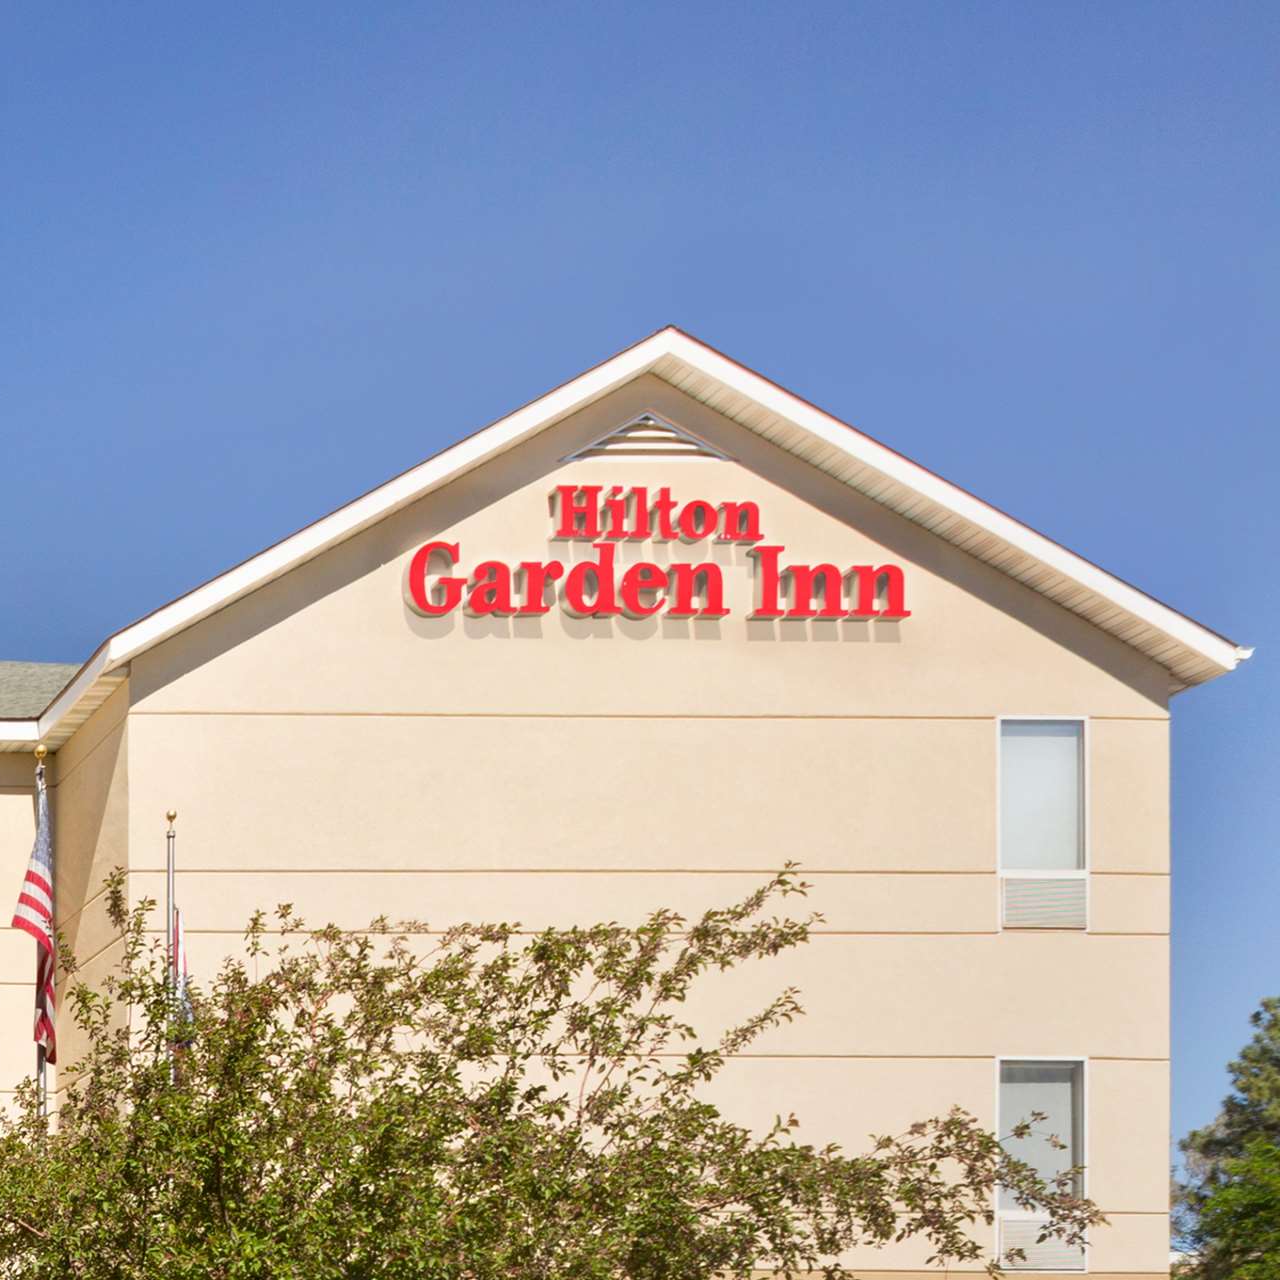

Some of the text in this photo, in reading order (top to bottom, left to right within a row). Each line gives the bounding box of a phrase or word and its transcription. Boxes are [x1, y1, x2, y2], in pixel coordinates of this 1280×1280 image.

[553, 484, 765, 542] Hilton
[407, 540, 912, 619] Garden Inn
